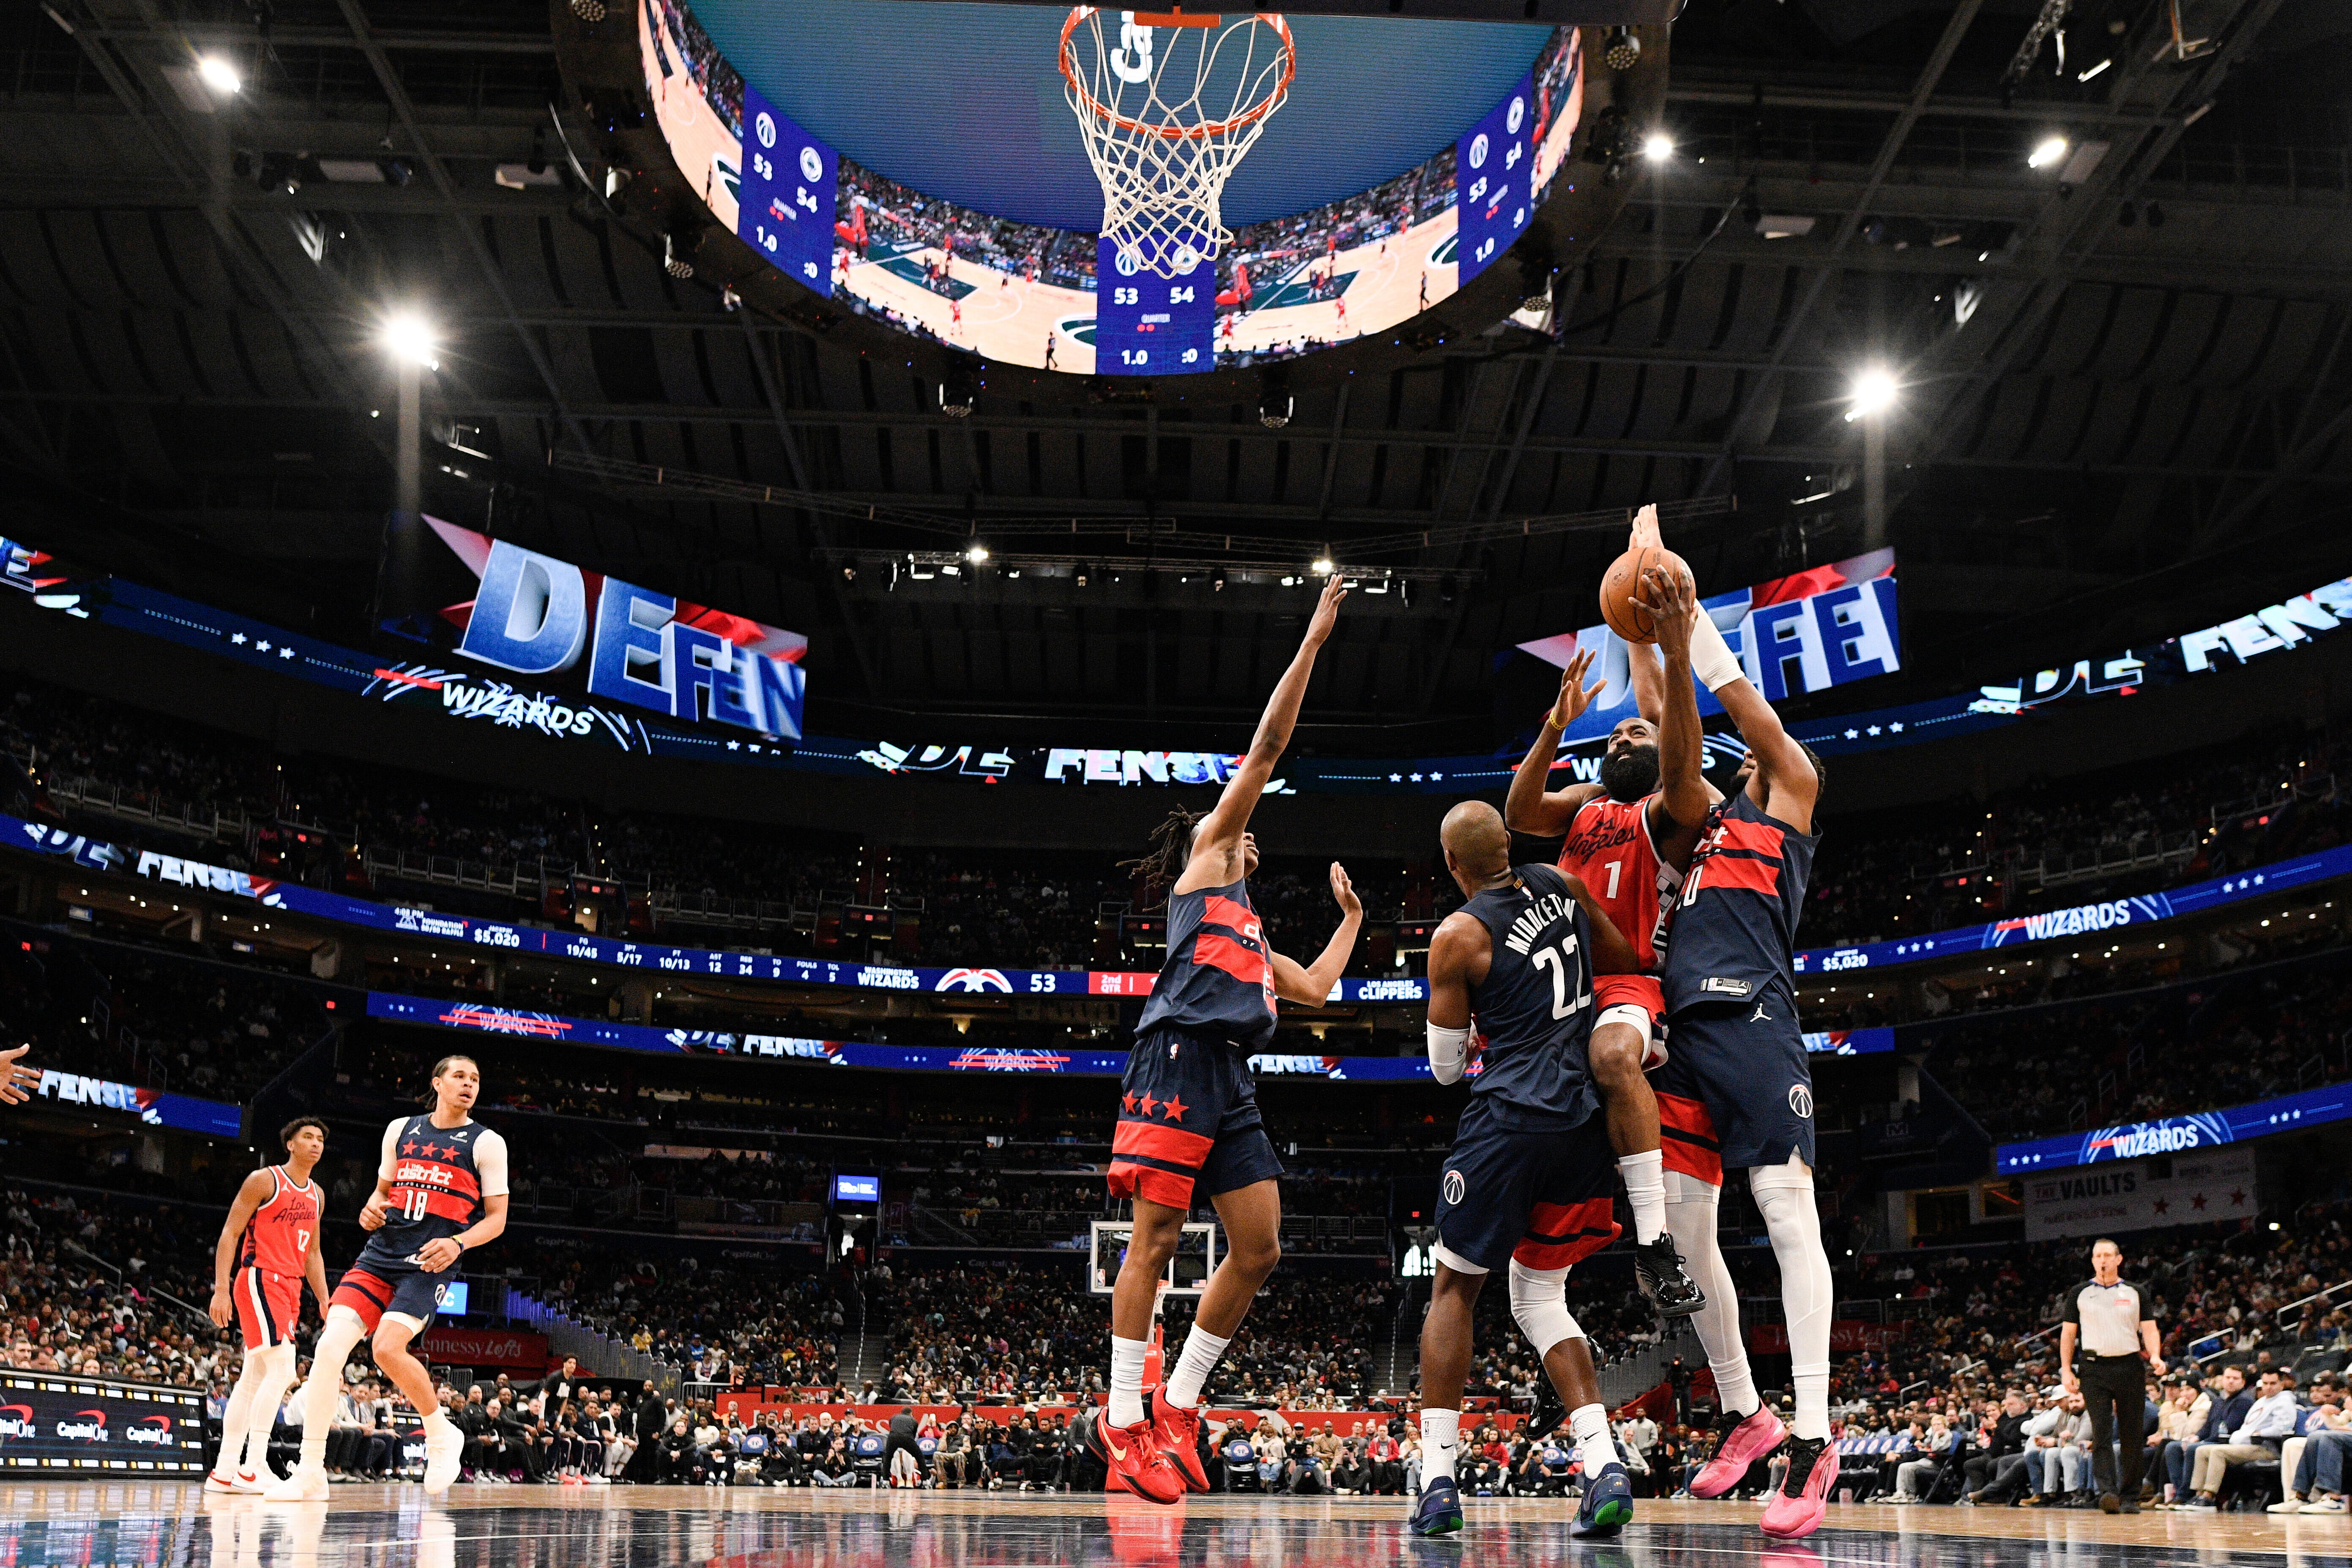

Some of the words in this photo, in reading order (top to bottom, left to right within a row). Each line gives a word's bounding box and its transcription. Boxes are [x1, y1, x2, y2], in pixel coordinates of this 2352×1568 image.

[1110, 11, 1154, 83] Ca
[754, 153, 772, 181] 53
[1506, 141, 1522, 170] 54
[796, 186, 818, 213] 54
[1469, 176, 1487, 203] 53
[756, 226, 777, 252] 1.0
[1476, 237, 1494, 262] 1.0
[1114, 287, 1138, 304] 53
[1170, 286, 1195, 304] 54
[1121, 349, 1148, 365] 1.0
[442, 683, 593, 735] WIZARDS
[1560, 824, 1637, 865] Angeles
[137, 850, 257, 898] FENSE
[1604, 861, 1621, 898] 1
[412, 910, 424, 919] PM
[422, 917, 463, 930] FOUNDATION
[1505, 894, 1575, 955] MIDDLETN
[2025, 900, 2130, 939] WIZARDS
[474, 928, 520, 947] $5,020
[567, 944, 597, 959] 19/45
[617, 952, 642, 965] 5/17
[659, 957, 690, 970] 10/13
[708, 961, 722, 972] 12
[739, 964, 752, 975] 34
[773, 967, 780, 977] 9
[801, 970, 809, 980] 4
[829, 972, 836, 982] 5
[797, 961, 817, 969] FOULS
[827, 963, 840, 971] TOL
[864, 966, 913, 977] WASHINGTON
[1823, 954, 1868, 971] $5,020
[858, 973, 919, 989] WIZARDS
[1030, 974, 1056, 992] 53
[1101, 974, 1121, 984] 2nd
[1101, 984, 1121, 993] QTR
[1532, 933, 1591, 1020] 22
[1359, 986, 1422, 1000] CLIPPERS
[743, 1034, 830, 1057] FENSE
[38, 1069, 142, 1113] FENSE
[2113, 1125, 2198, 1157] WIZARDS
[397, 1161, 453, 1185] district
[2060, 1171, 2136, 1199] VAULTS
[290, 1197, 305, 1210] Los
[404, 1189, 428, 1221] 18
[272, 1208, 315, 1226] Angeles
[298, 1229, 310, 1253] 12
[420, 1338, 486, 1358] ennessy
[486, 1338, 521, 1358] Lofts
